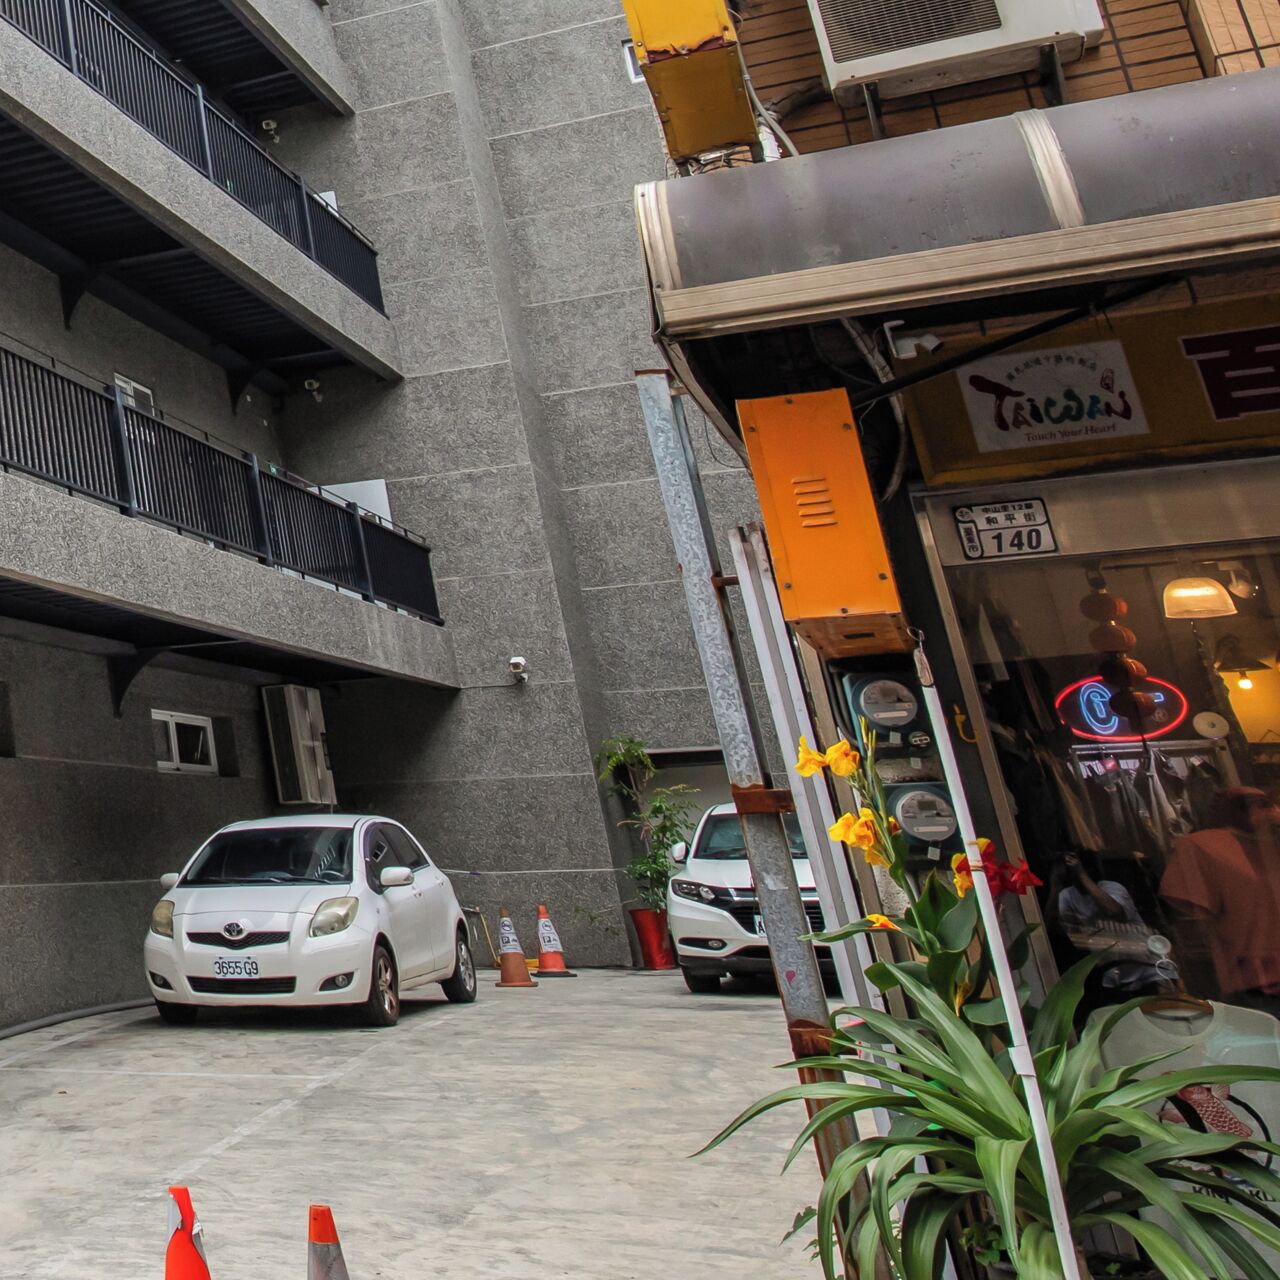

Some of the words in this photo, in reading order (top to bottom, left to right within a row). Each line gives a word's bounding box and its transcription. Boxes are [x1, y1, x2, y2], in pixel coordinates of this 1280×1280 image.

[1024, 431, 1057, 442] Touch
[1084, 423, 1116, 436] Heart
[985, 512, 1037, 526] 和平街
[991, 528, 1042, 553] 140
